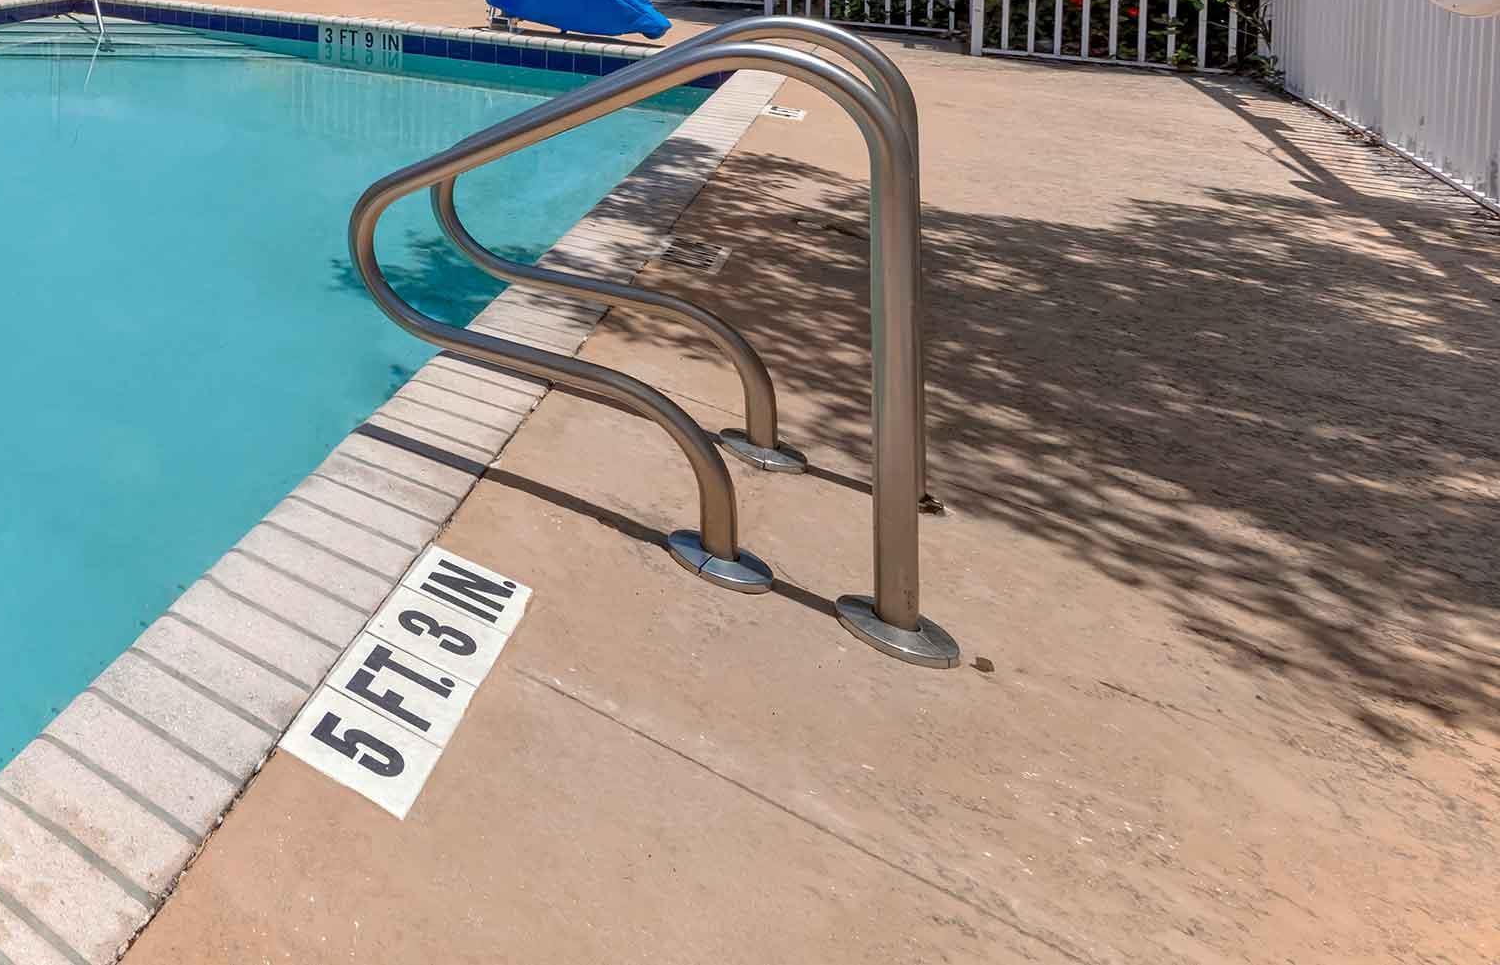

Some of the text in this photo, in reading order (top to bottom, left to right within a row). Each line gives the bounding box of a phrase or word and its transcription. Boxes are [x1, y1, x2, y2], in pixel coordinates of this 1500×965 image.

[325, 27, 399, 52] 3 FT 9 IN
[310, 559, 517, 778] 5 FT. 3 IN.
